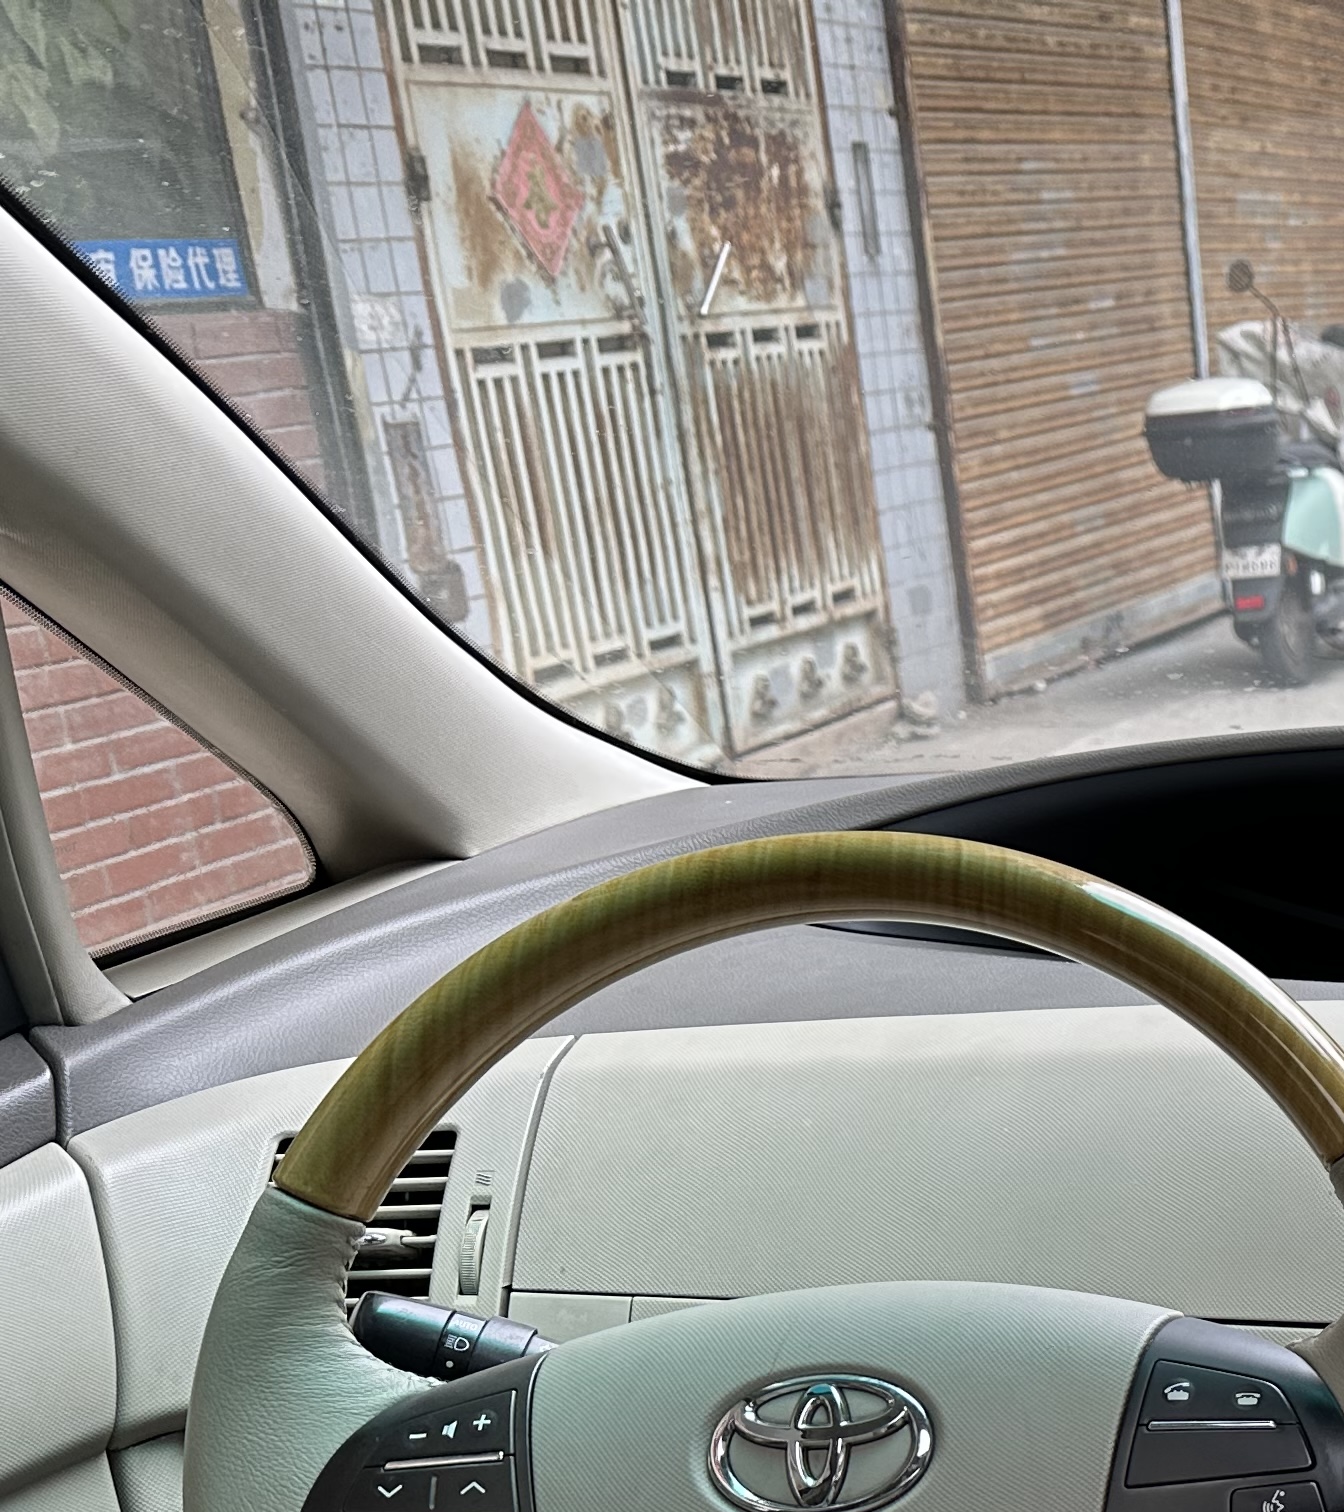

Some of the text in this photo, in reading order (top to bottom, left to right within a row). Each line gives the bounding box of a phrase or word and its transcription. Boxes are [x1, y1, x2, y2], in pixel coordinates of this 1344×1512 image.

[130, 246, 242, 290] 保险代理
[453, 1318, 479, 1332] AUTO
